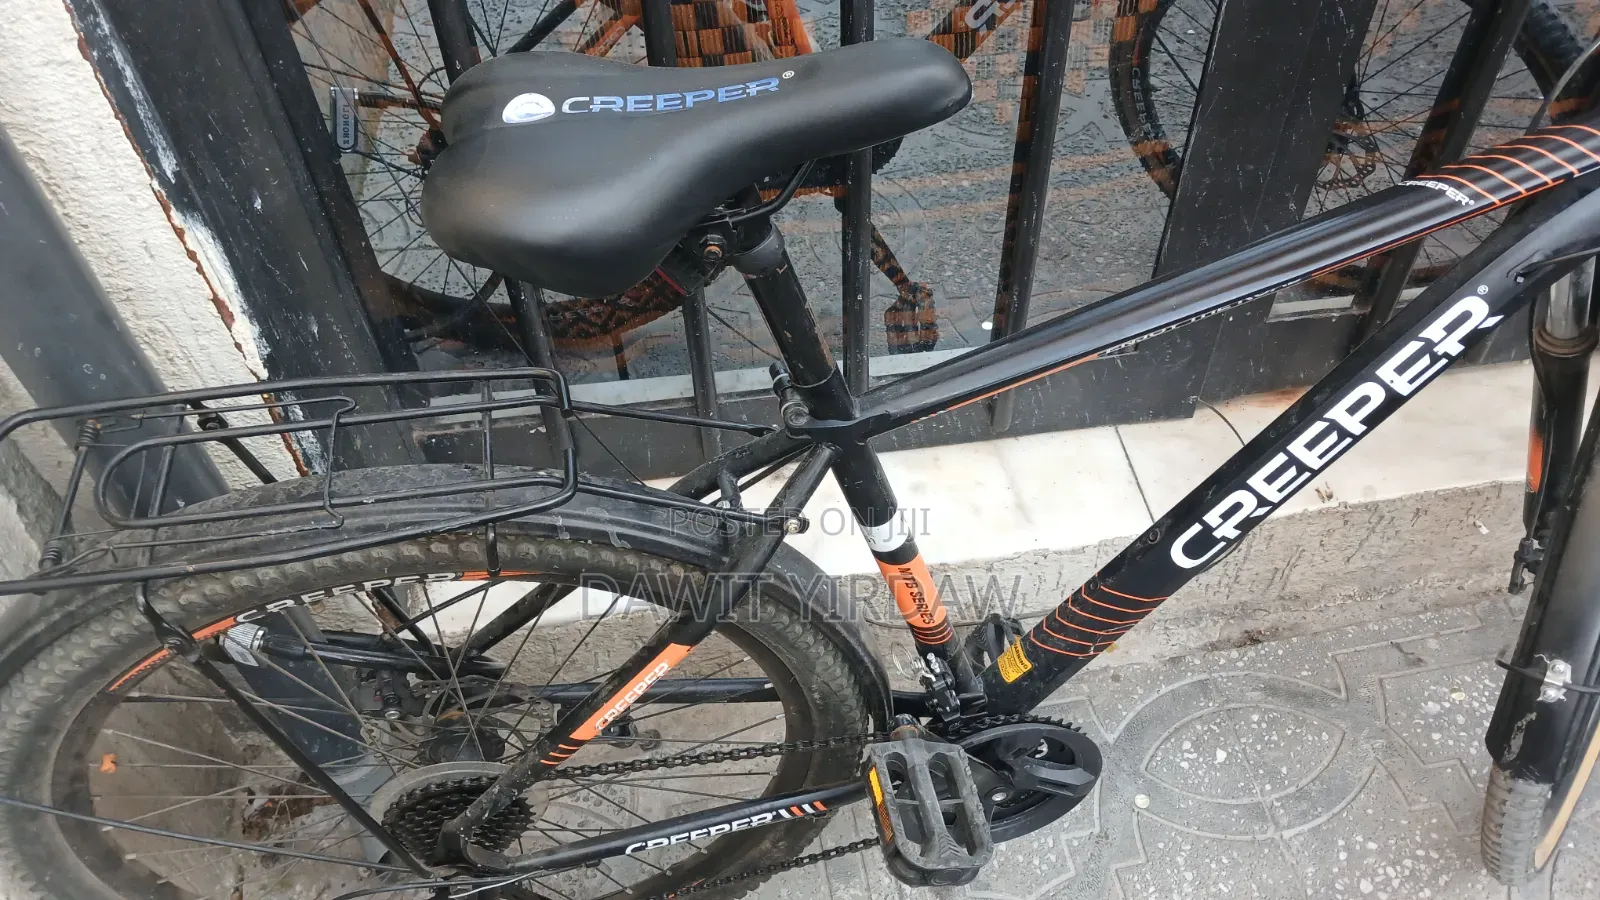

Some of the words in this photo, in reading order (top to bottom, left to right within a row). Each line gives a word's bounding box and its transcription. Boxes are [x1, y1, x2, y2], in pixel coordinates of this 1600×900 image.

[562, 77, 779, 114] CREEPER
[1397, 180, 1470, 206] CREEPER
[1169, 294, 1505, 570] CREEPER
[898, 567, 918, 589] MTB
[910, 591, 935, 625] SERIES
[596, 664, 670, 731] CREEPER
[626, 814, 770, 855] CREEPER
